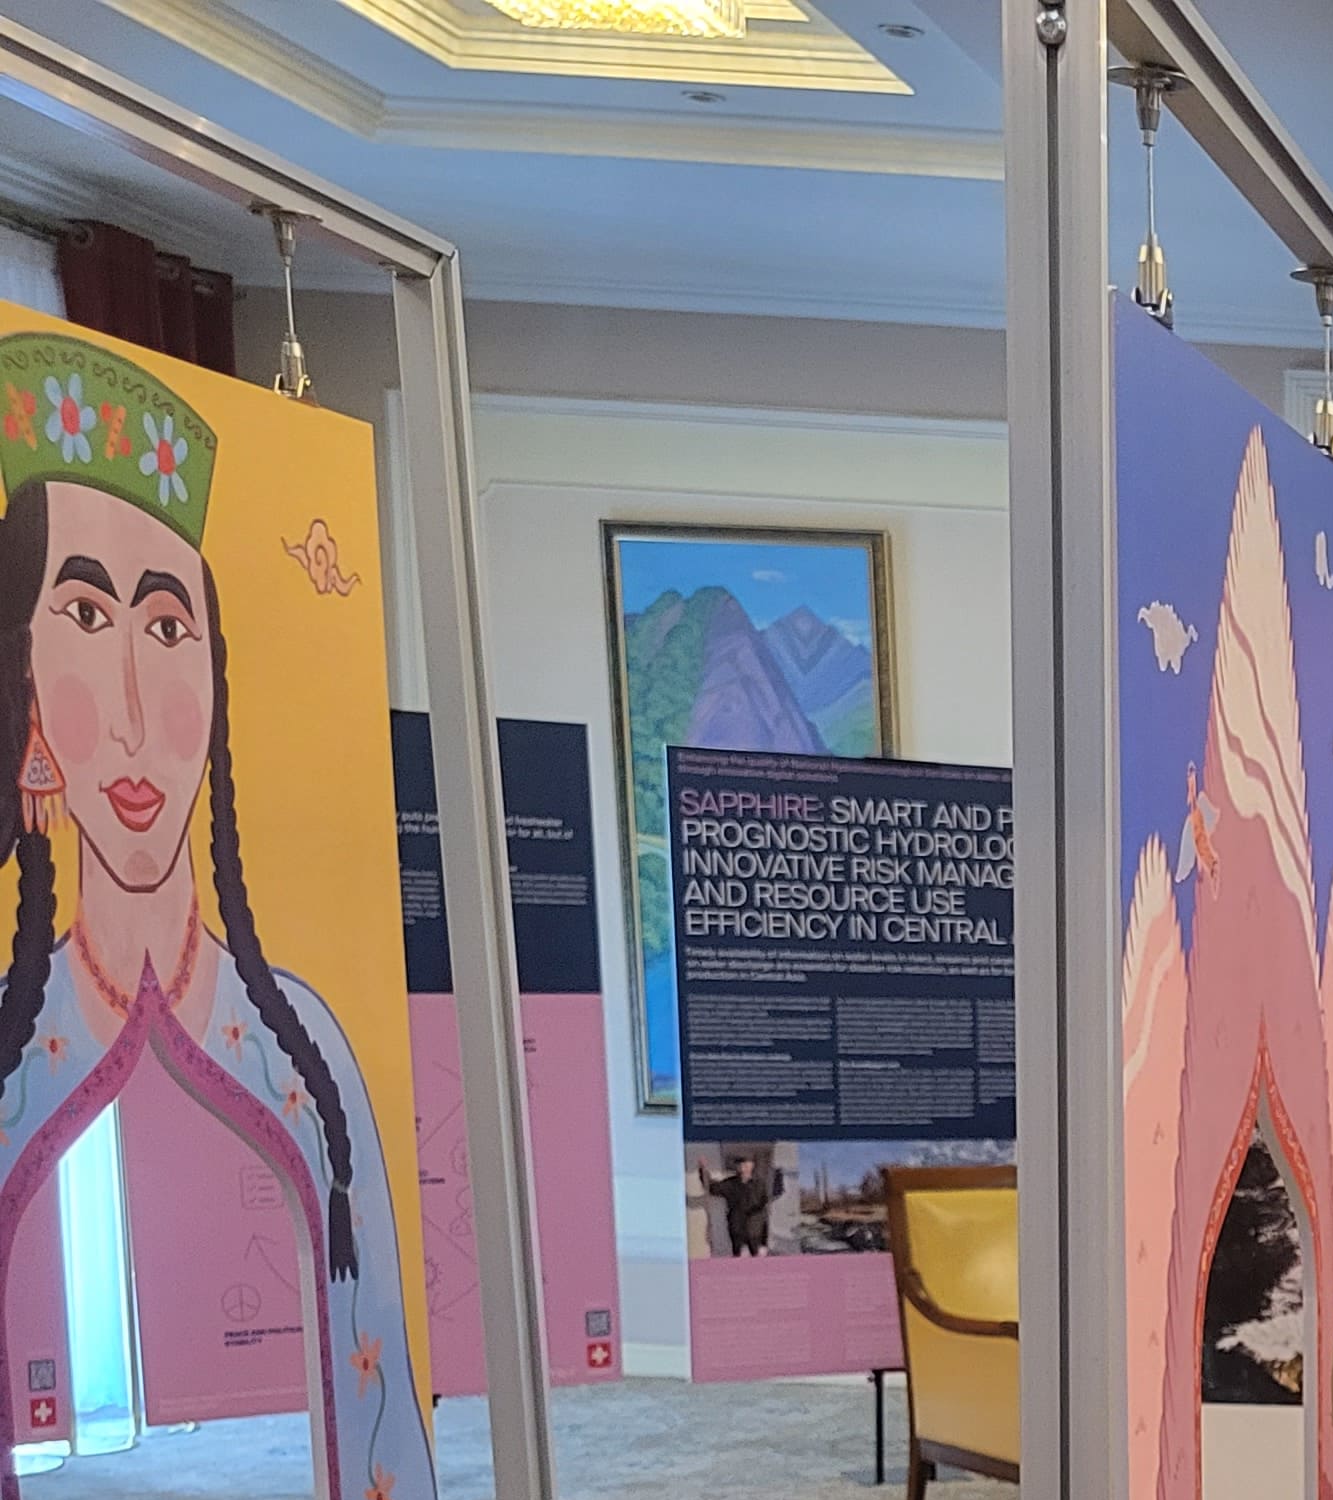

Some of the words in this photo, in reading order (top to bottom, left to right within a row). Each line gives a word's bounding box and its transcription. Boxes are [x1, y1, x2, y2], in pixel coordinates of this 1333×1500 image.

[680, 790, 824, 822] SAPPHIRE
[830, 796, 927, 826] SMART
[932, 803, 992, 832] AND
[680, 819, 871, 854] PROGNOSTIC
[683, 850, 845, 882] INNOVATIVE
[852, 857, 912, 886] RISK
[917, 859, 1014, 890] MANAG
[684, 879, 748, 909] AND
[753, 882, 906, 914] RESOURCE
[911, 889, 967, 916] USE
[684, 908, 843, 940] EFFICIENCY
[851, 916, 877, 942] IN
[881, 916, 1008, 947] CENTRAL
